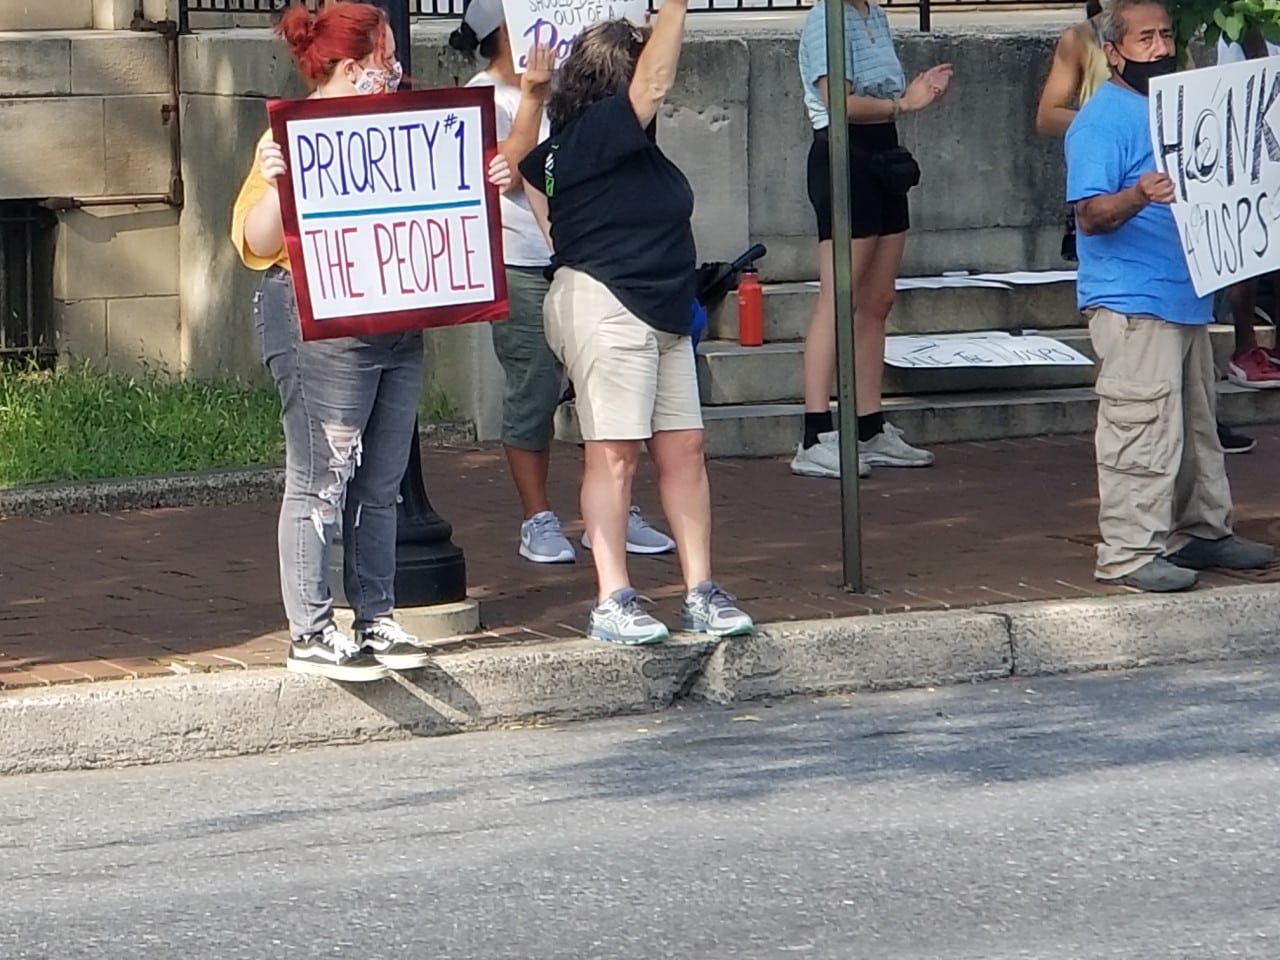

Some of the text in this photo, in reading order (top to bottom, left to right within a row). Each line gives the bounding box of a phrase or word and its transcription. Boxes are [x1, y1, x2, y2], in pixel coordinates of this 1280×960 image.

[554, 6, 582, 26] OUT
[587, 5, 603, 22] OF
[297, 113, 470, 200] PRIORITY #1
[305, 215, 485, 300] THE PEOPLE
[1205, 192, 1269, 276] USPS
